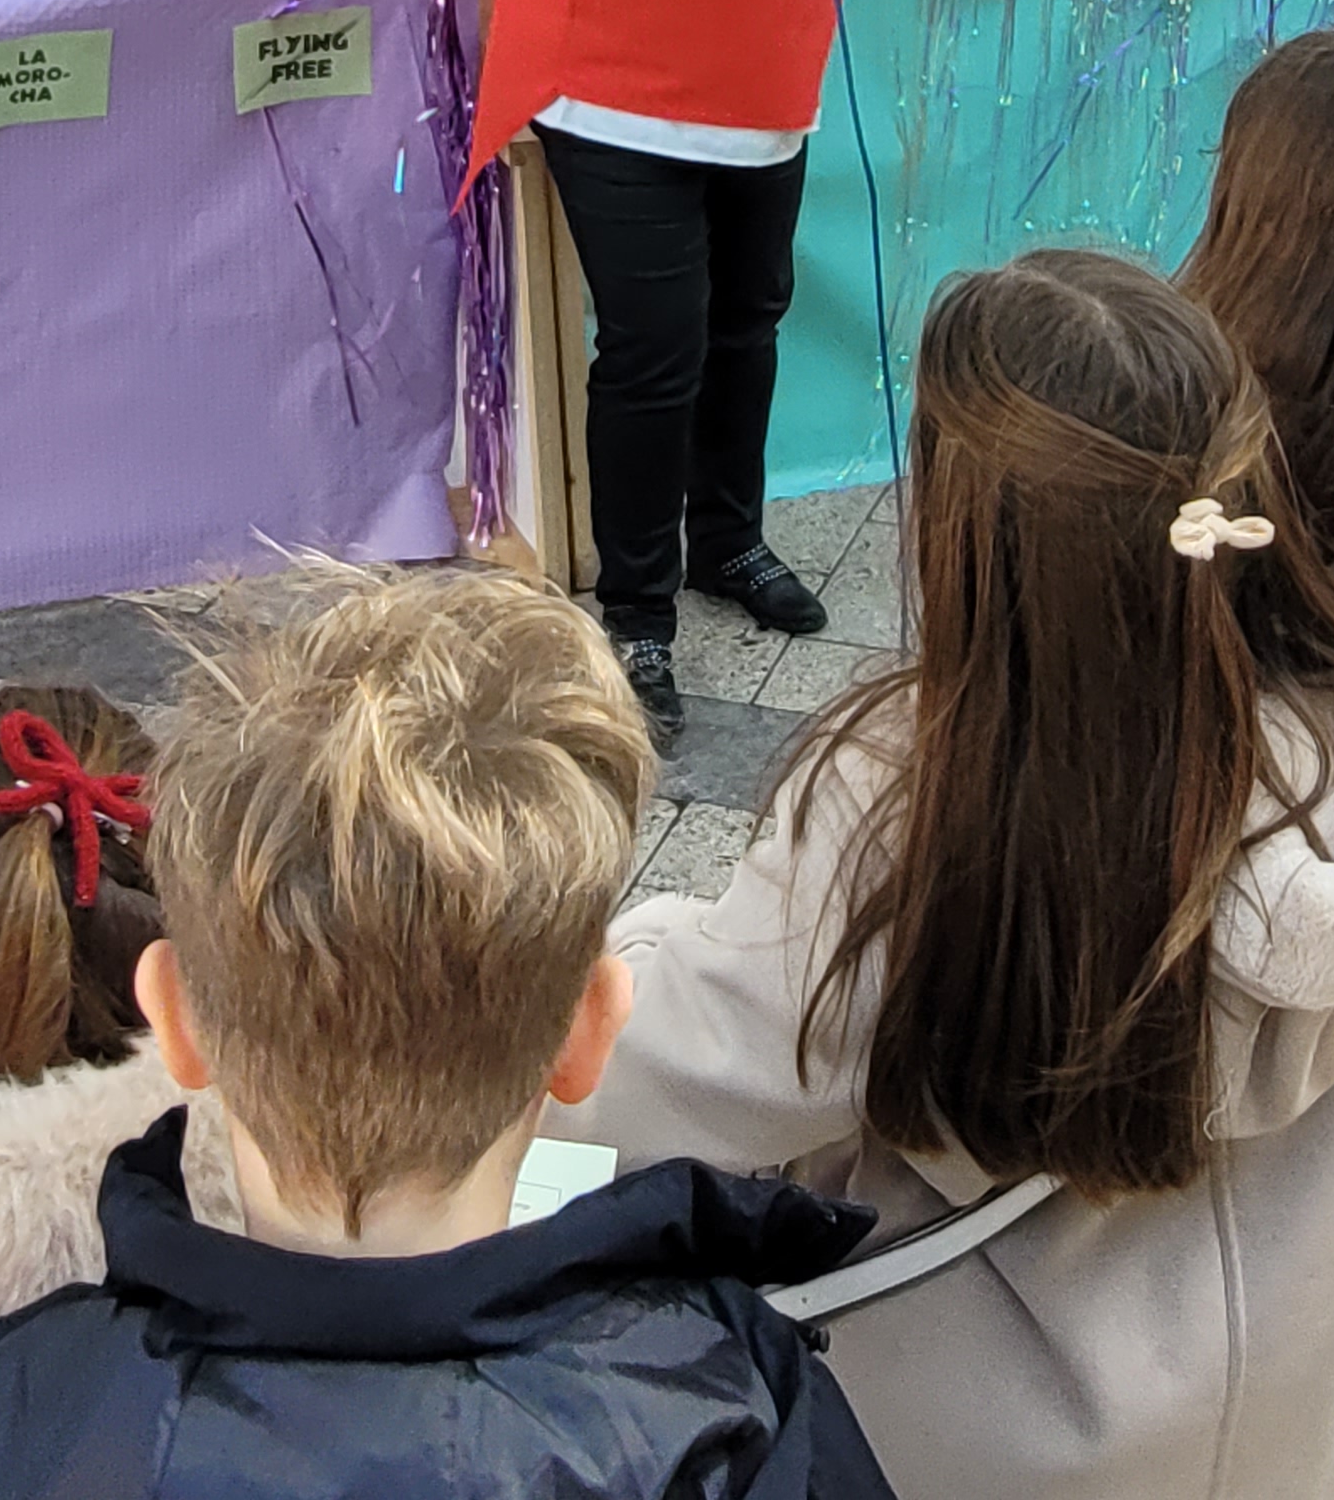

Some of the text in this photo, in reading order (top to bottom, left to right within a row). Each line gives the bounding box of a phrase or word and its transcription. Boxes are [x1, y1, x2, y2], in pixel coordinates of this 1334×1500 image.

[258, 30, 349, 61] FLYING
[17, 48, 47, 67] LA
[270, 58, 332, 84] FREE
[9, 83, 53, 104] CHA
